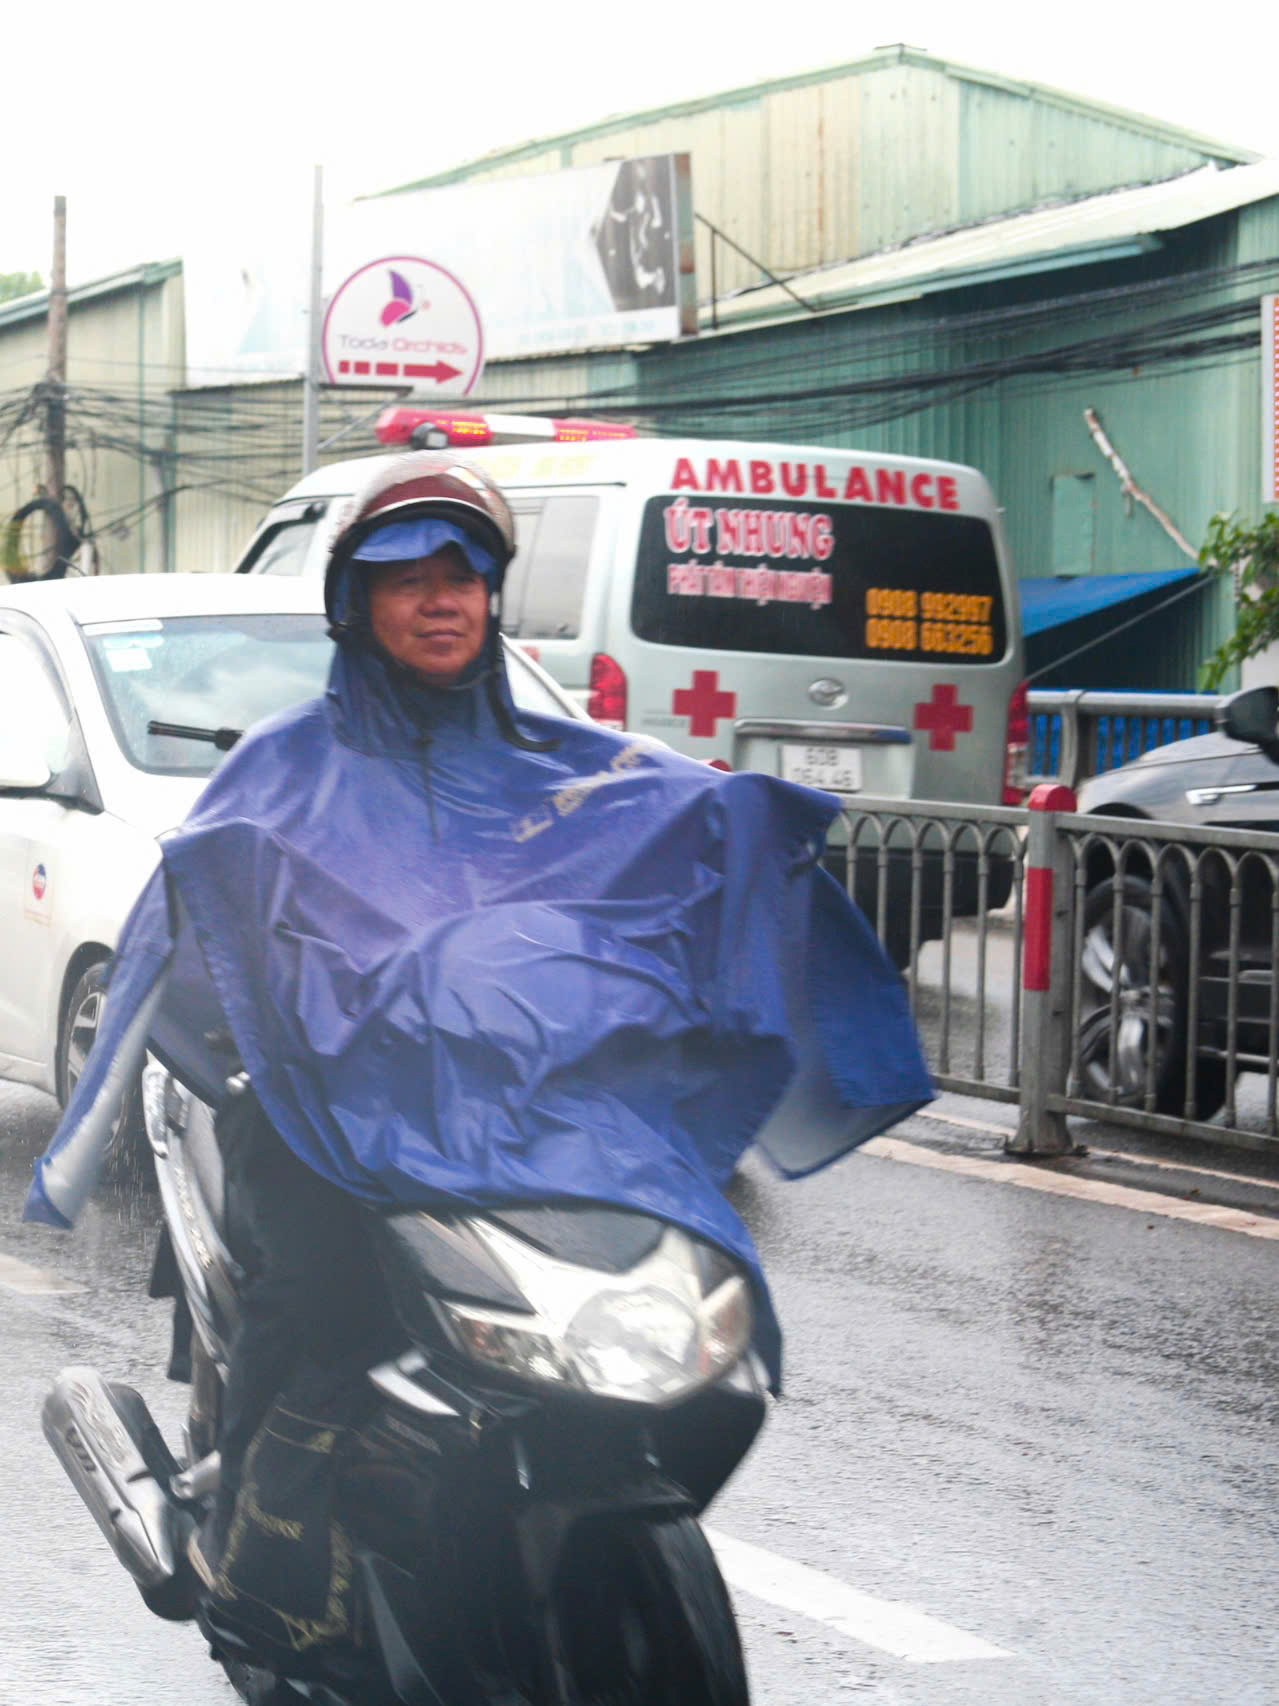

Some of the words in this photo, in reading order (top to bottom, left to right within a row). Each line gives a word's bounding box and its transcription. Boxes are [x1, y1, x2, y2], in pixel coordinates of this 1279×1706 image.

[670, 457, 960, 511] AMBULANCE
[663, 496, 713, 554] ÚT
[715, 508, 835, 561] NHUNG
